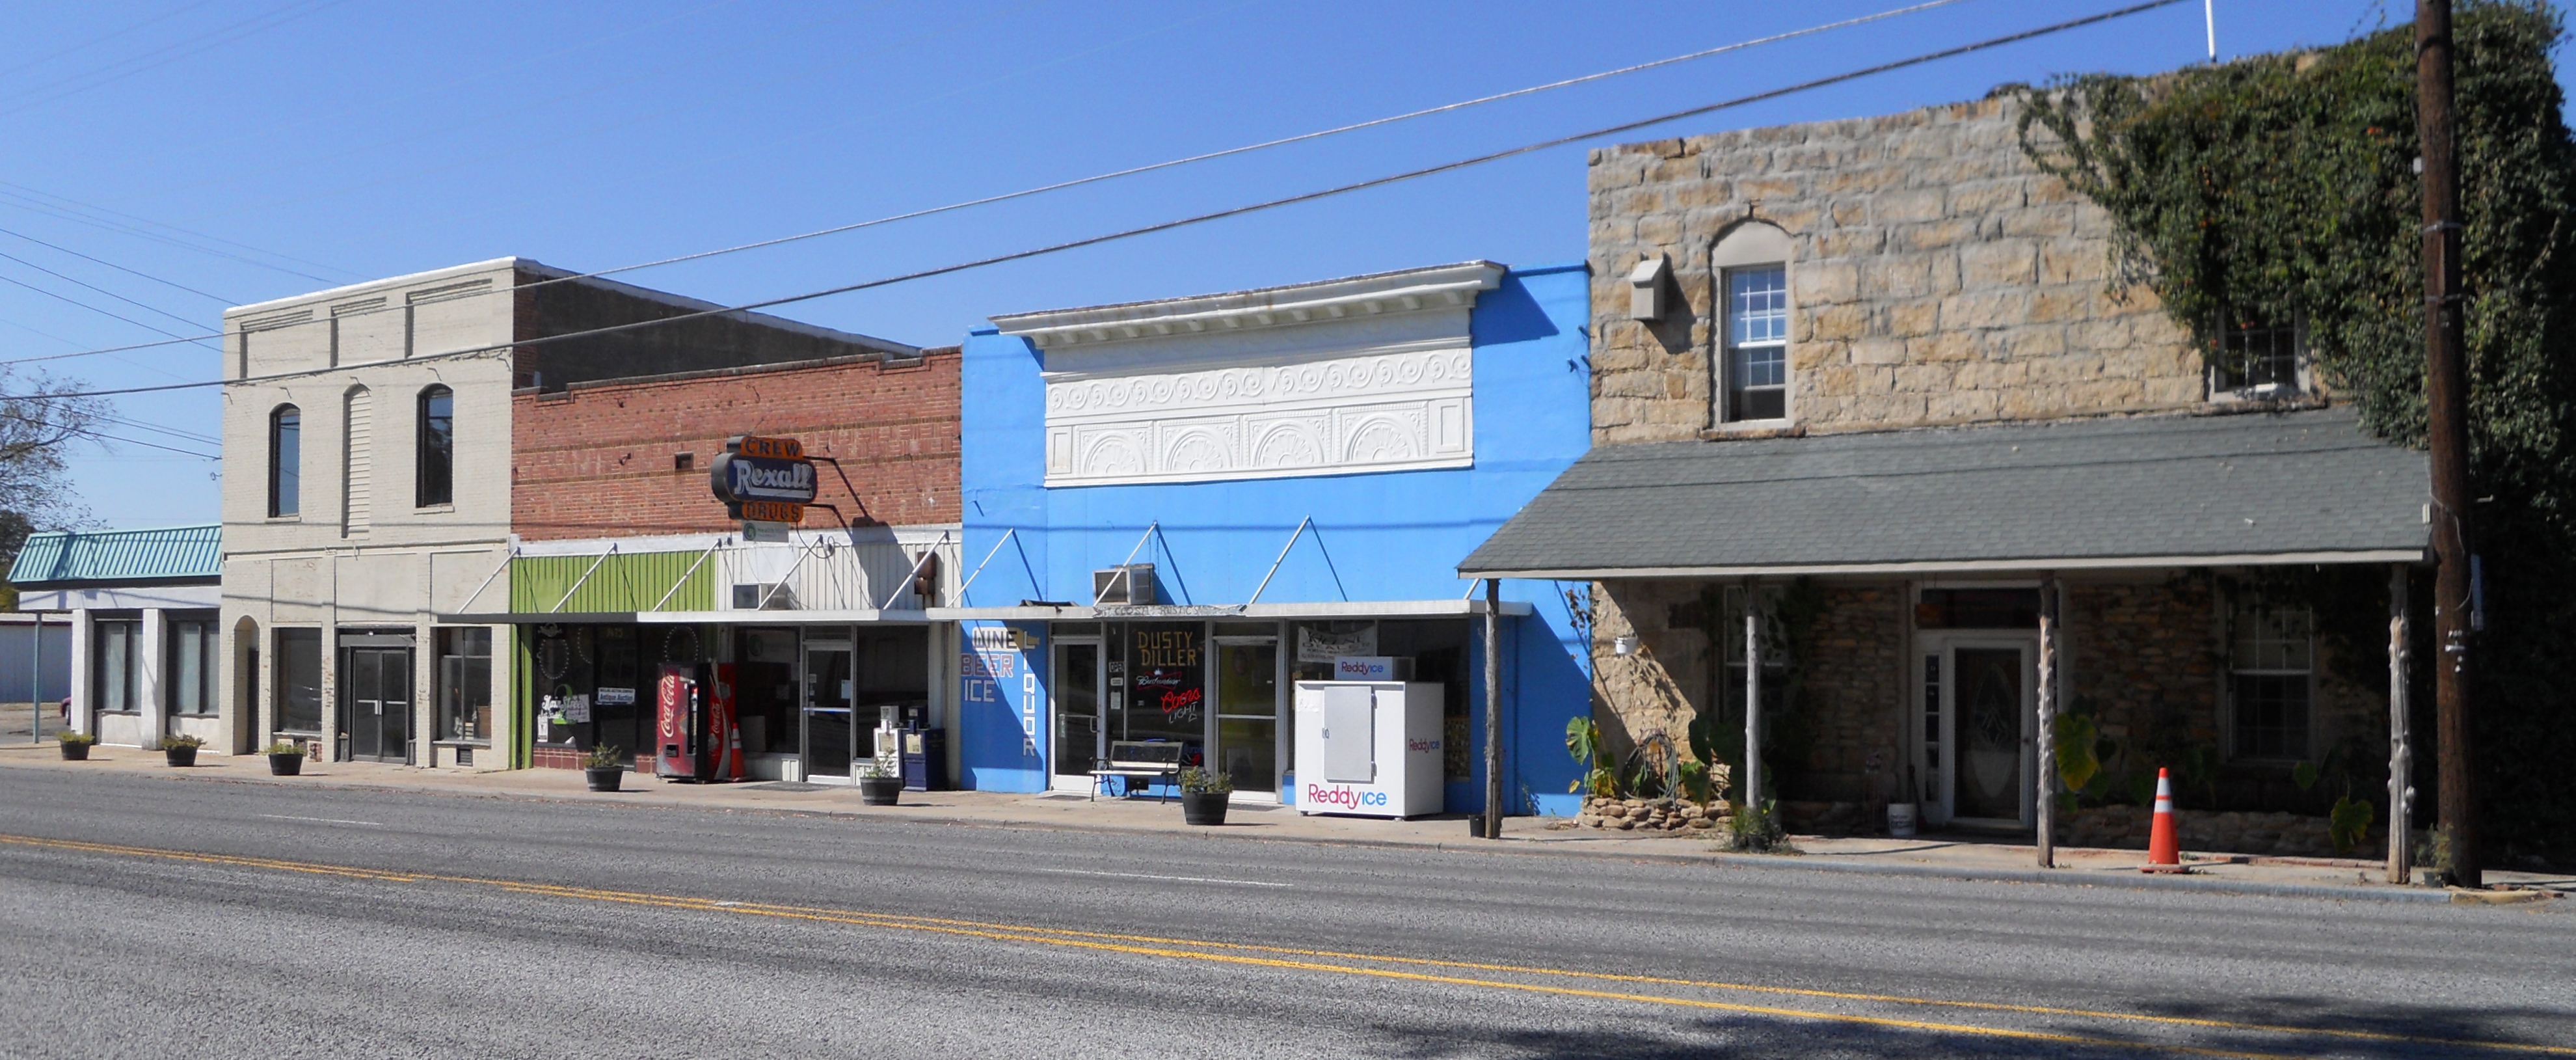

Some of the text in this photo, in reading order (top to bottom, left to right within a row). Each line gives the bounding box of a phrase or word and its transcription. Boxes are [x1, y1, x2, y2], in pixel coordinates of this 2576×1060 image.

[745, 438, 800, 457] CREW
[733, 459, 813, 497] Rexall
[747, 502, 800, 521] DRUGS
[973, 630, 1017, 649] WINE
[1138, 631, 1193, 649] DUSTY
[961, 653, 1014, 678] BEER
[1110, 662, 1124, 672] OPEN
[1142, 649, 1196, 666] DILLER
[1136, 675, 1181, 685] Budweiser
[965, 679, 995, 702] ICE
[1023, 630, 1036, 757] LIQUOR
[1161, 688, 1201, 713] Coors
[1169, 701, 1198, 724] LIGHT
